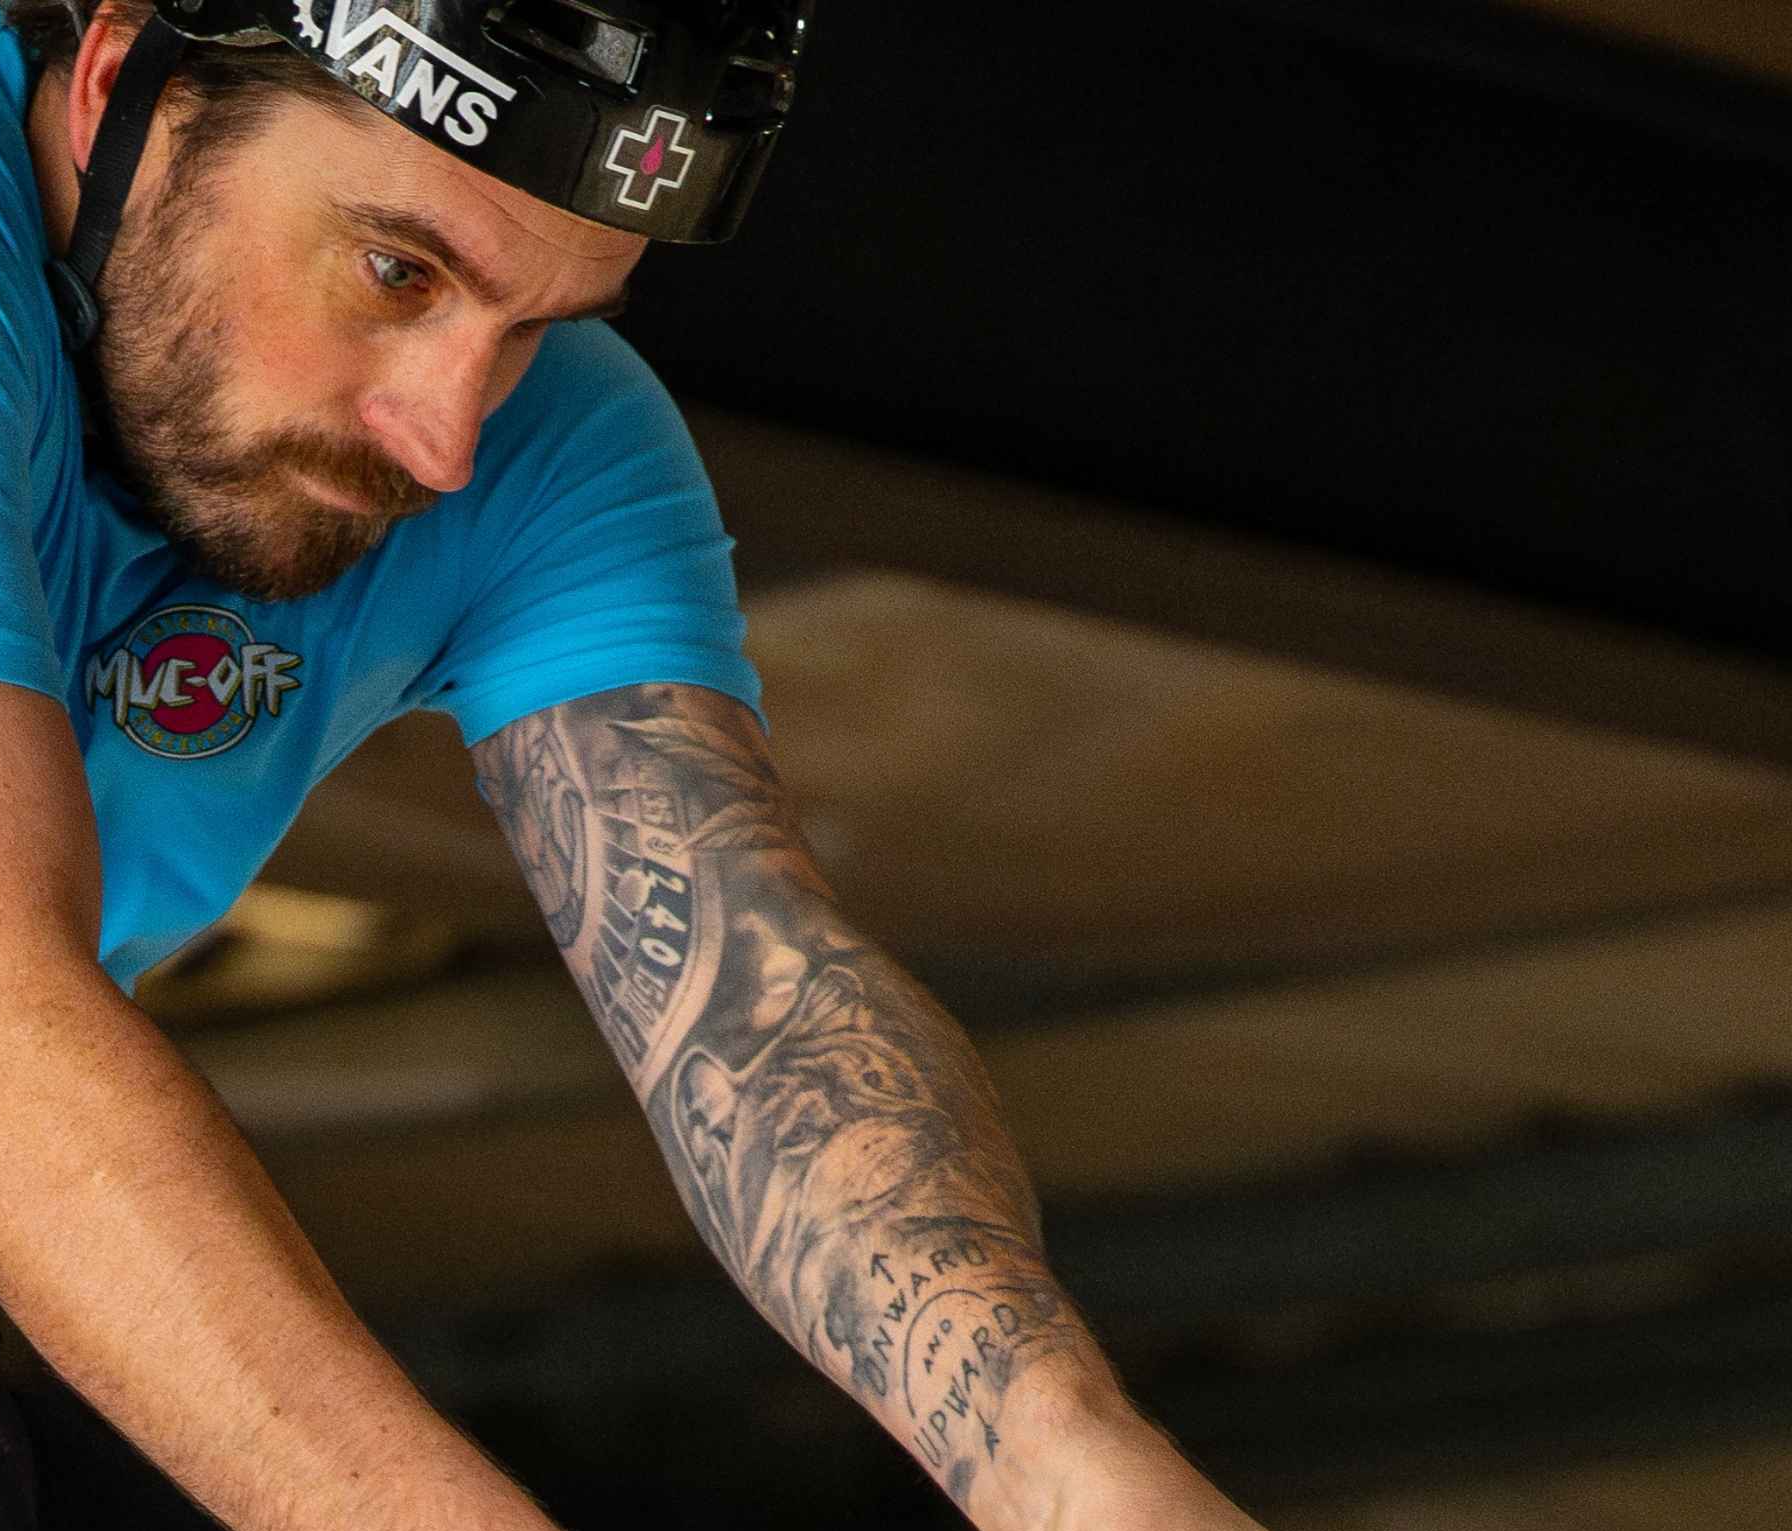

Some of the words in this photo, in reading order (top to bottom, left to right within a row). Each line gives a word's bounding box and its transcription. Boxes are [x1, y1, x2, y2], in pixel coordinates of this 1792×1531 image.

[325, 0, 517, 148] VANS
[864, 1242, 989, 1397] ONWARD
[913, 1304, 1018, 1468] UPWARD
